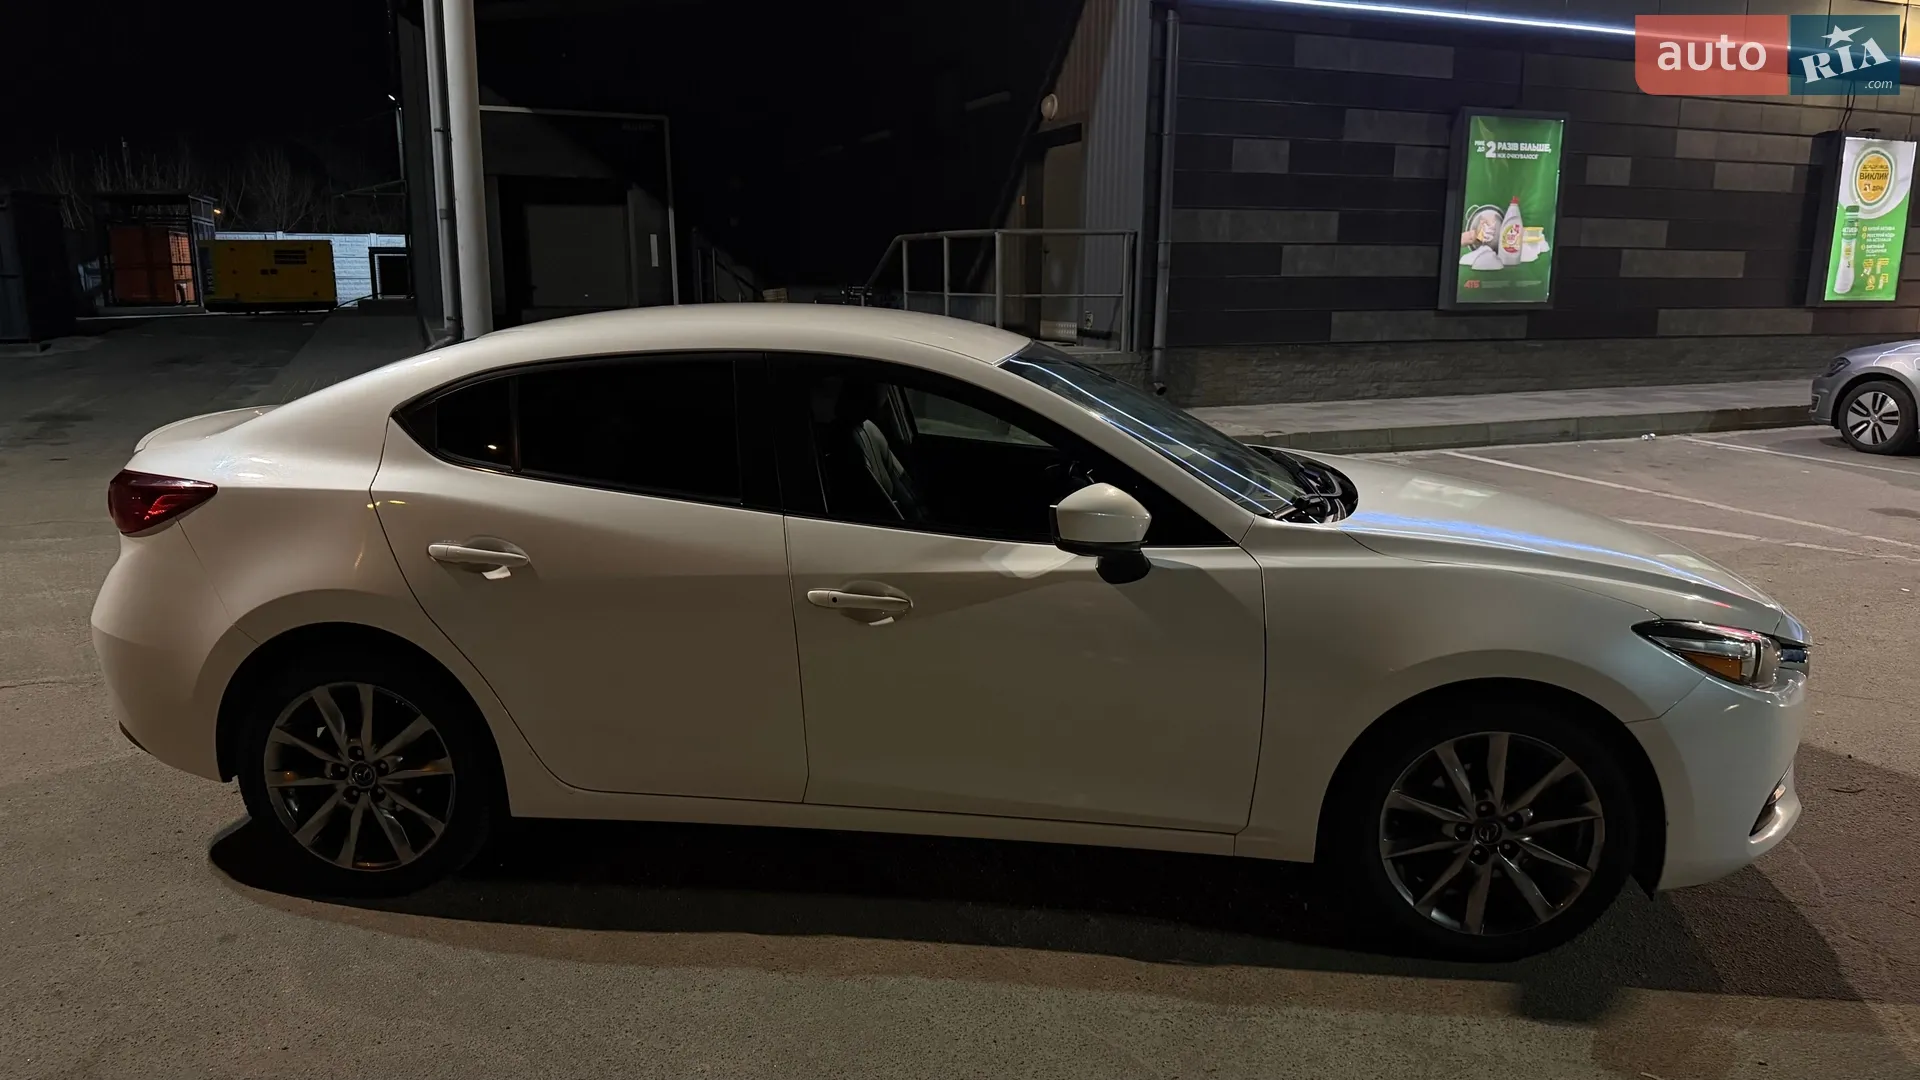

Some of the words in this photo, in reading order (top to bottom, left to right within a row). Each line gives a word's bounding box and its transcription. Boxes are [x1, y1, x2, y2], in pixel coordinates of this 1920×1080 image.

[1485, 141, 1497, 158] 2
[1497, 142, 1519, 151] РАЗІВ
[1859, 172, 1889, 180] ВИКЛИК
